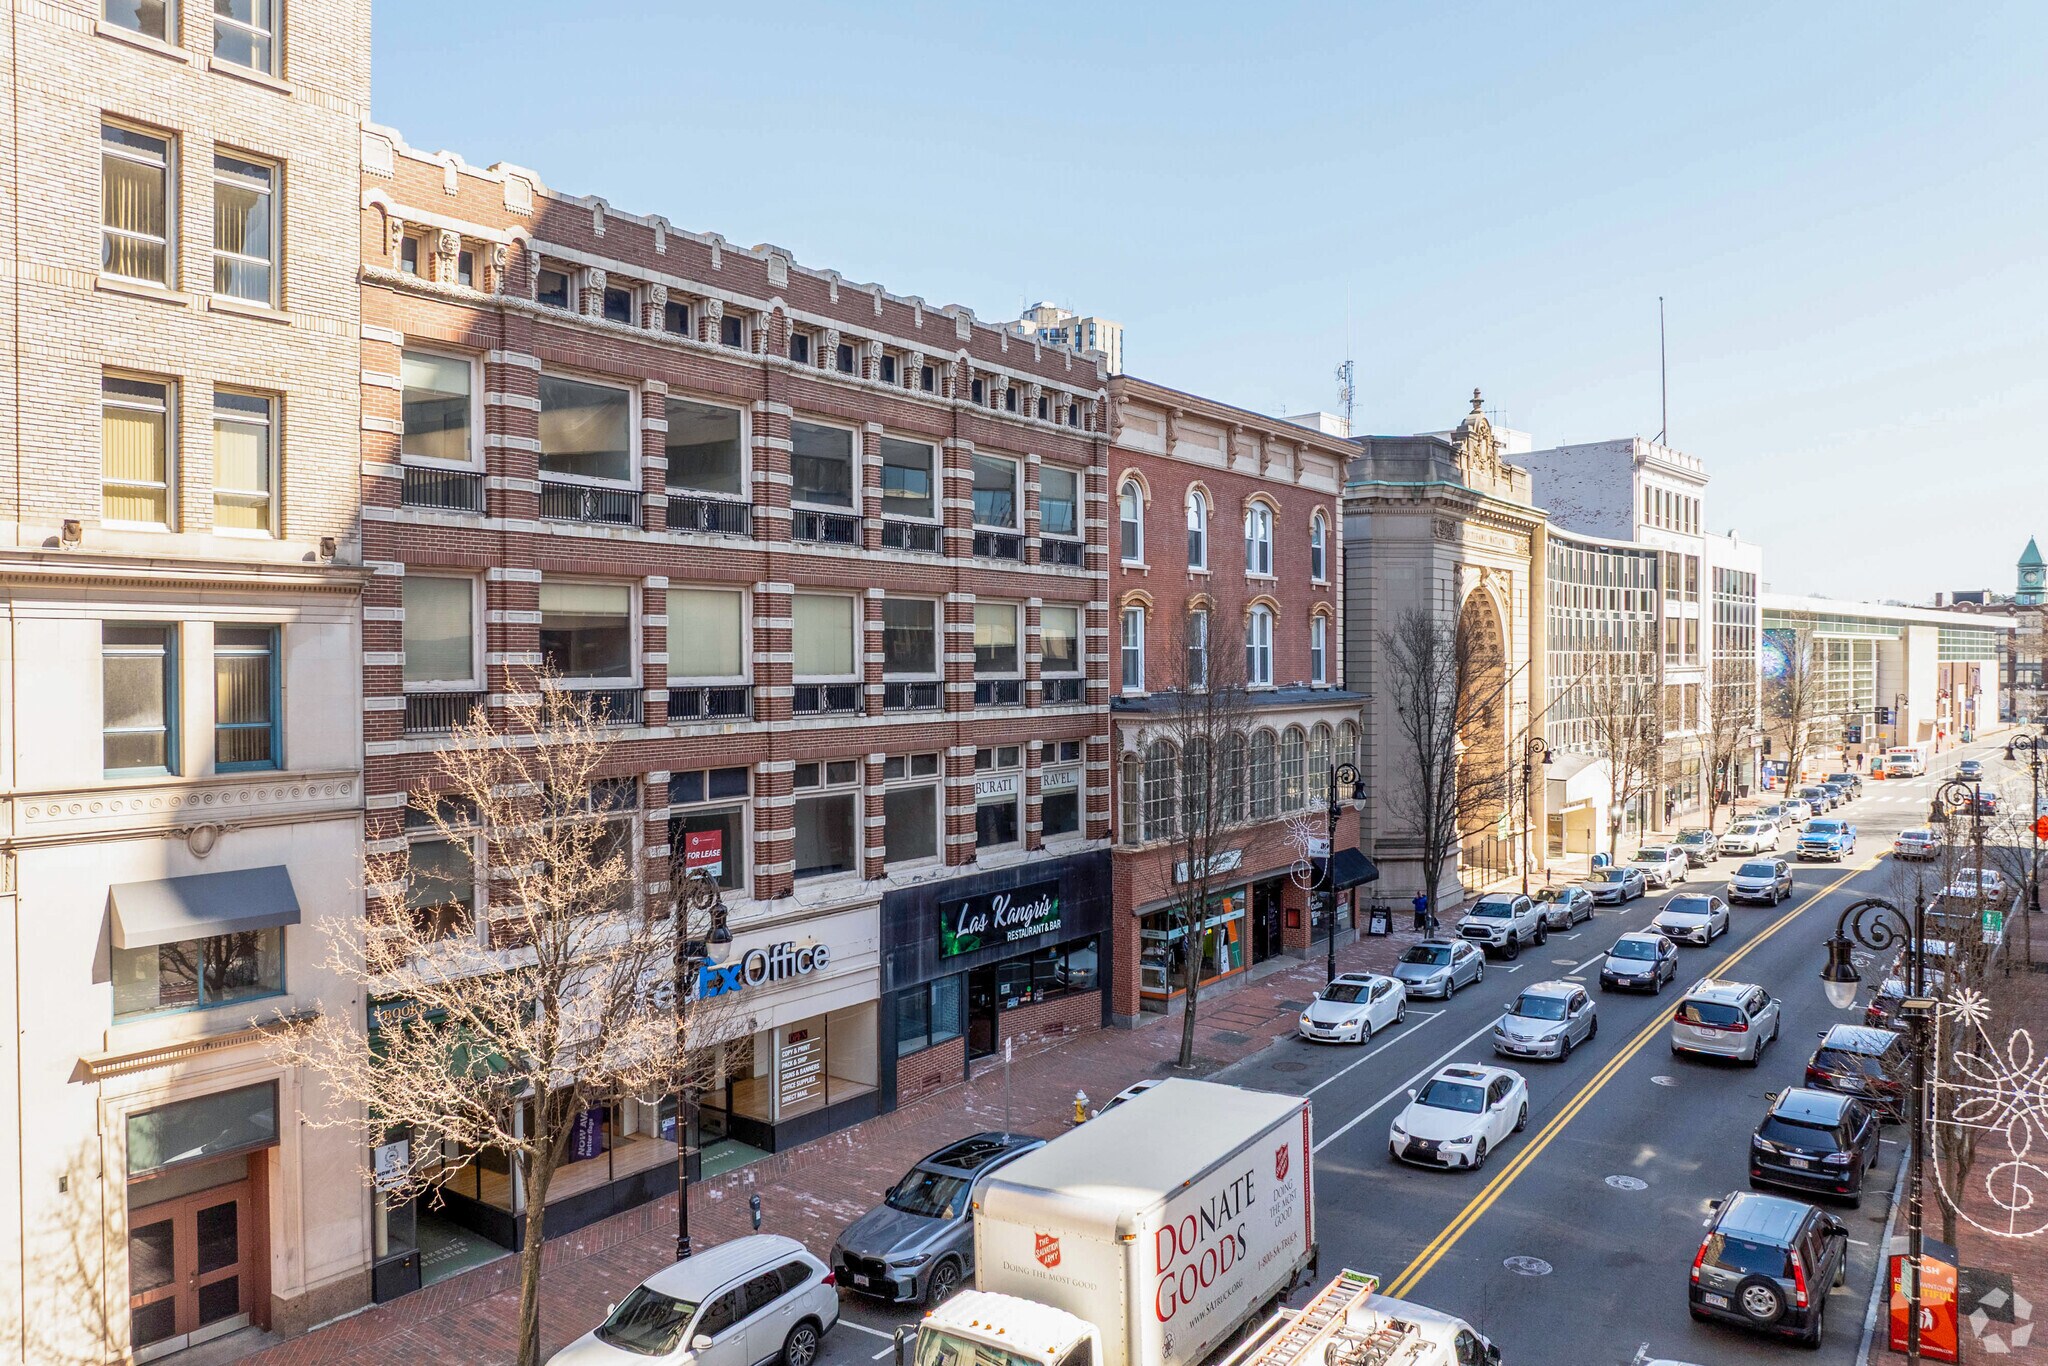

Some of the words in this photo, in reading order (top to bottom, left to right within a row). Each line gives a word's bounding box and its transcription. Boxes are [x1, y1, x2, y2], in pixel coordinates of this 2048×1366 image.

[975, 778, 1012, 795] BURATI
[687, 851, 700, 860] FOR
[701, 848, 721, 858] LEASE
[956, 903, 988, 939] Las
[1007, 922, 1045, 942] RESTAURANT
[1044, 922, 1049, 932] &
[1049, 919, 1062, 932] BAR
[741, 941, 831, 987] Office
[782, 1048, 794, 1058] COPY
[797, 1043, 811, 1053] PRINT
[782, 1060, 794, 1069] PACK
[797, 1056, 808, 1065] SHIP
[782, 1071, 796, 1081] SIGNS
[800, 1063, 820, 1075] BANNERS
[782, 1082, 797, 1092] OFFICE
[796, 1075, 816, 1087] SUPPLIES
[782, 1094, 797, 1104] DIRECT
[796, 1089, 808, 1098] MAIL
[578, 1129, 587, 1156] NOW
[377, 1169, 391, 1178] NOW
[391, 1164, 408, 1173] OEN
[1273, 1178, 1294, 1202] DOING
[1269, 1204, 1281, 1219] THE
[1281, 1187, 1298, 1208] MOST
[1154, 1168, 1256, 1278] DONATE
[1274, 1206, 1293, 1228] GOOD
[1039, 1236, 1050, 1247] THE
[1043, 1251, 1059, 1265] ARMY
[1003, 1261, 1030, 1276] DOING
[1032, 1269, 1047, 1279] THE
[1049, 1273, 1070, 1285] MOST
[1072, 1278, 1097, 1291] GOOD
[1155, 1222, 1246, 1323] GOODS
